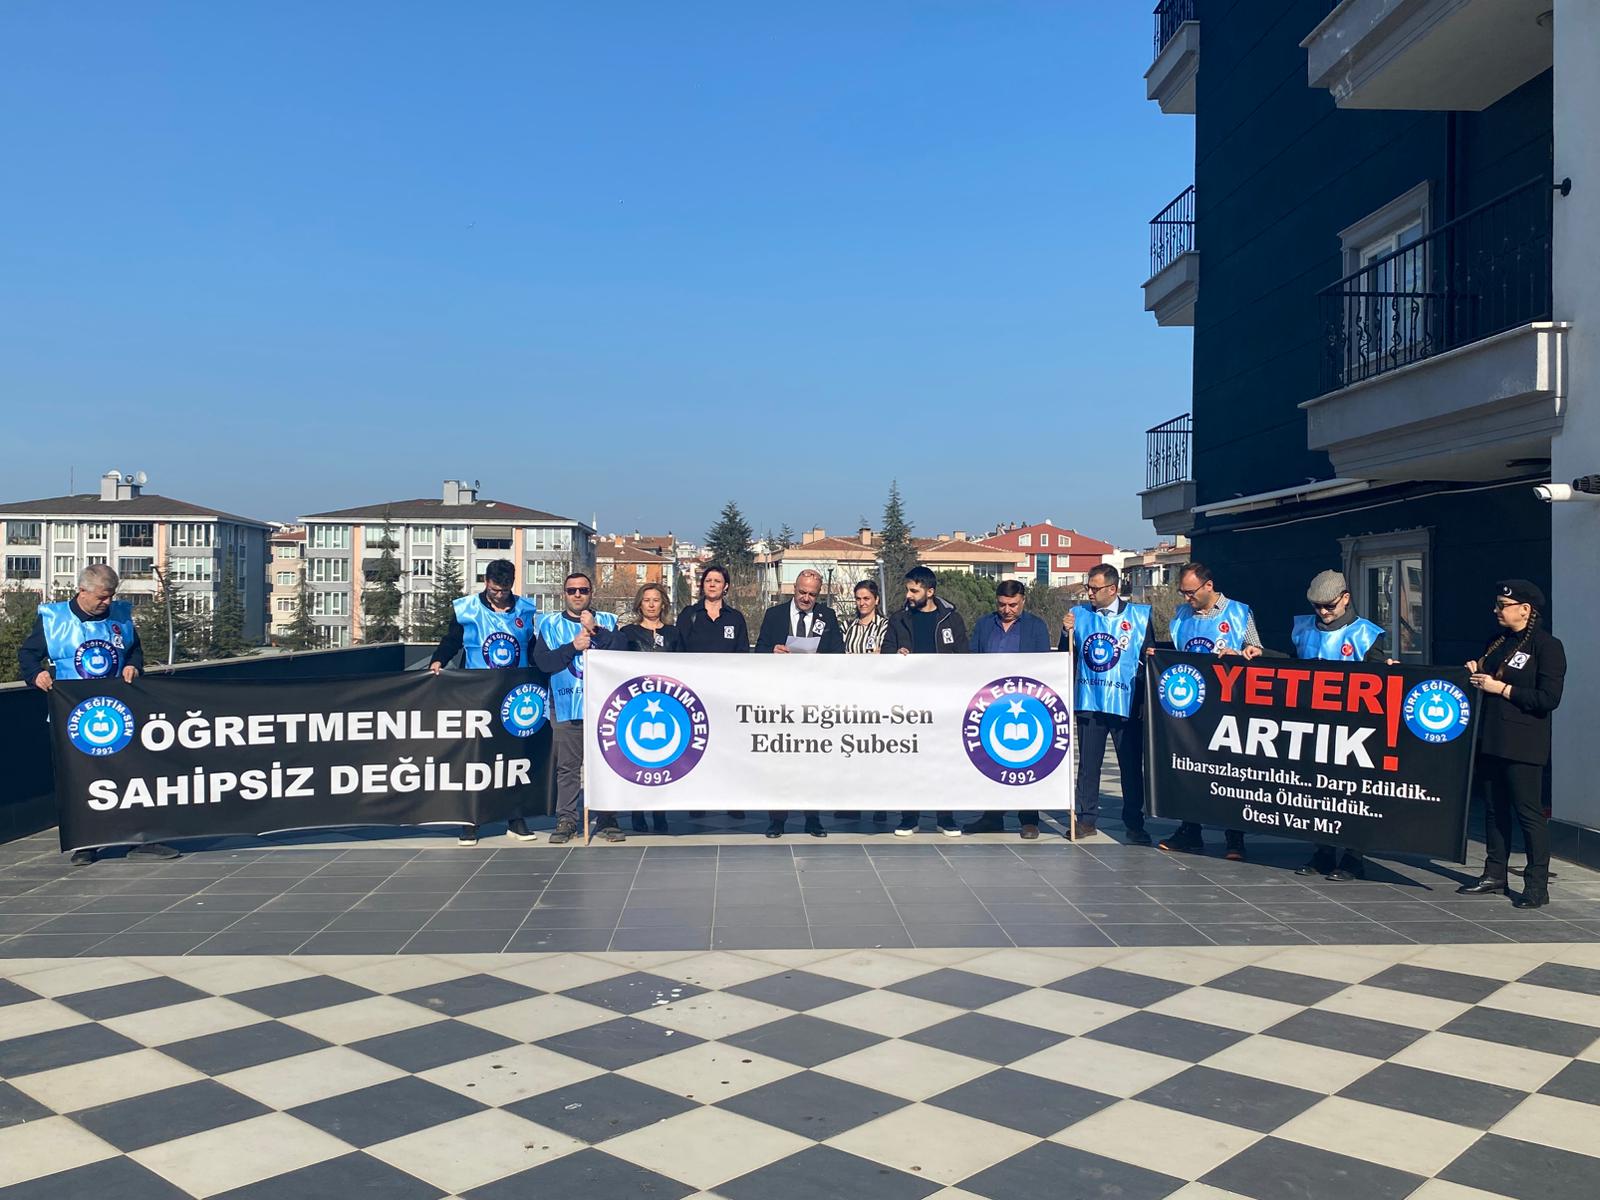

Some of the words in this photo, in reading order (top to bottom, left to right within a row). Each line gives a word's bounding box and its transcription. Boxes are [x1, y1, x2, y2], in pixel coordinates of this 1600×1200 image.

[69, 708, 84, 739] TÜRK
[84, 697, 134, 737] EĞİTİM-SEN
[600, 694, 628, 752] TÜRK
[627, 677, 708, 751] EĞİTİM-SEN
[736, 704, 795, 724] Türk
[800, 704, 934, 729] Eğitim-Sen
[964, 696, 992, 752] TÜRK
[991, 678, 1069, 752] EĞİTİM-SEN
[1404, 689, 1421, 721] TÜRK
[1421, 680, 1469, 726] EĞİTİM-SEN
[140, 708, 494, 752] ÖĞRETMENLER
[750, 733, 833, 753] Edirne
[840, 733, 919, 758] Şubesi
[1424, 733, 1448, 742] 1992
[91, 746, 114, 755] 1992
[87, 761, 315, 811] SAHİPSİZ
[330, 753, 531, 795] DEĞİLDİR
[635, 770, 673, 784] 1992
[1000, 769, 1037, 784] 1992
[1171, 753, 1312, 788] İtibarsızlaştırıldık...
[1316, 773, 1358, 796] Darp
[1361, 779, 1441, 802] Edildik...
[1210, 781, 1272, 804] Sonunda
[1275, 788, 1384, 818] Öldürüldük...
[1242, 804, 1280, 826] Ötesi
[1283, 812, 1311, 831] Var
[1313, 817, 1342, 835] Mı?
